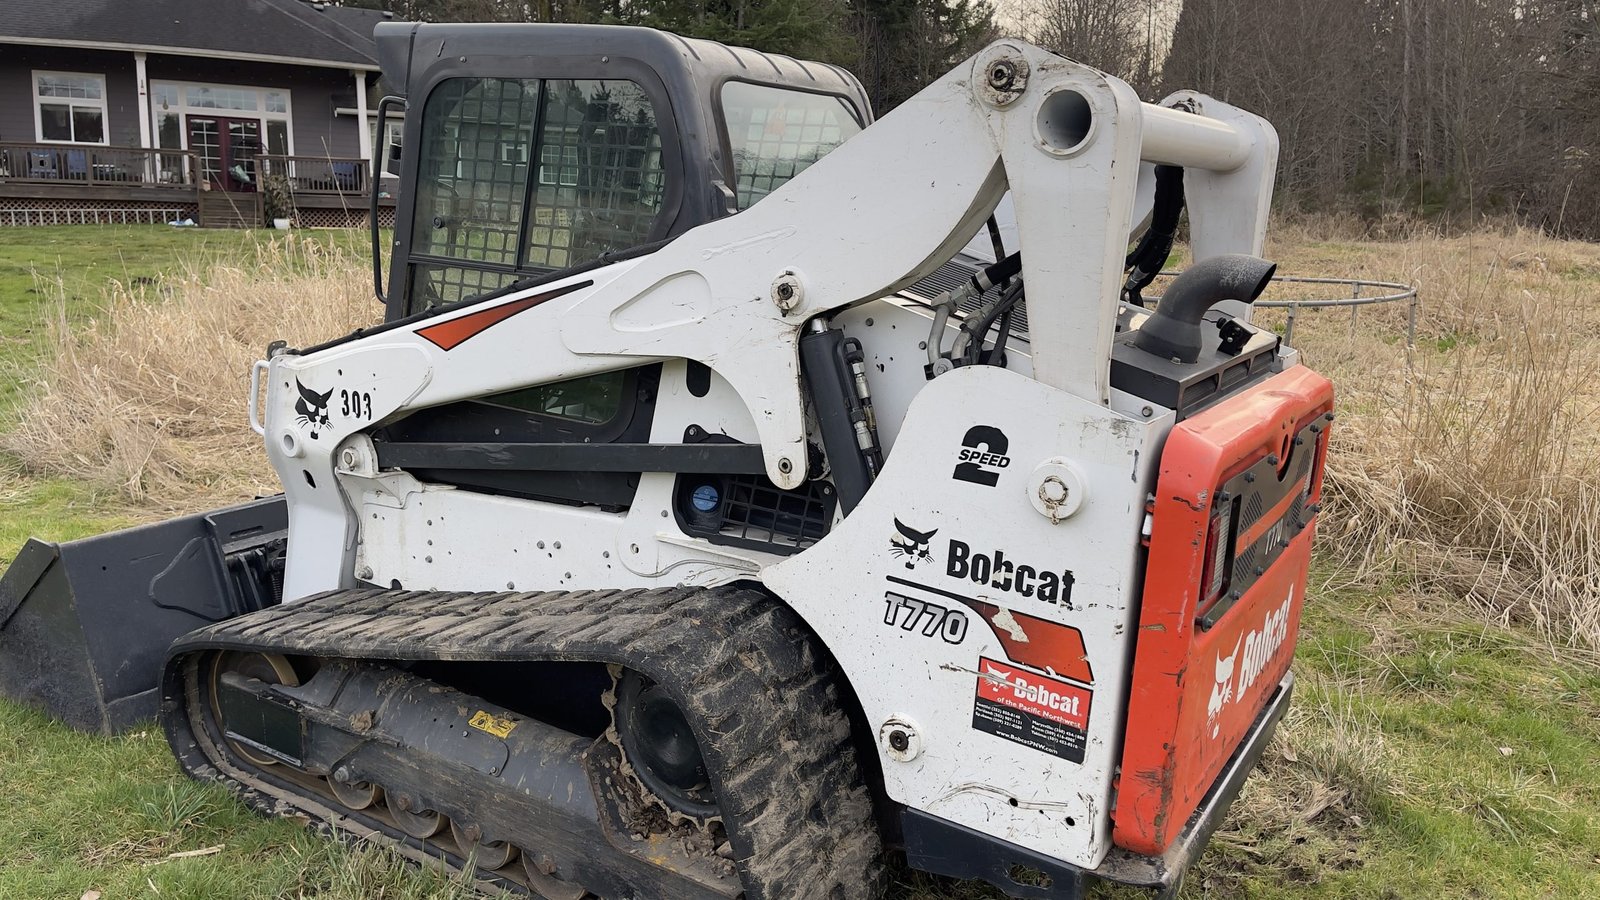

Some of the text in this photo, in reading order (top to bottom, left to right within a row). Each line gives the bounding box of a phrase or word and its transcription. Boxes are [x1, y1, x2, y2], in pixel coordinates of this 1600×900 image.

[341, 389, 372, 421] 303
[952, 424, 1009, 488] 2
[958, 449, 1011, 469] SPEED
[946, 538, 1076, 611] Bobcat
[883, 590, 969, 645] T770
[1236, 583, 1294, 704] Bobcat
[1005, 698, 1017, 707] the
[1018, 702, 1041, 715] Pacific
[1042, 710, 1081, 728] Northwest
[1014, 677, 1080, 716] Bobcat
[996, 730, 1058, 755] www.BobcatPNW.com
